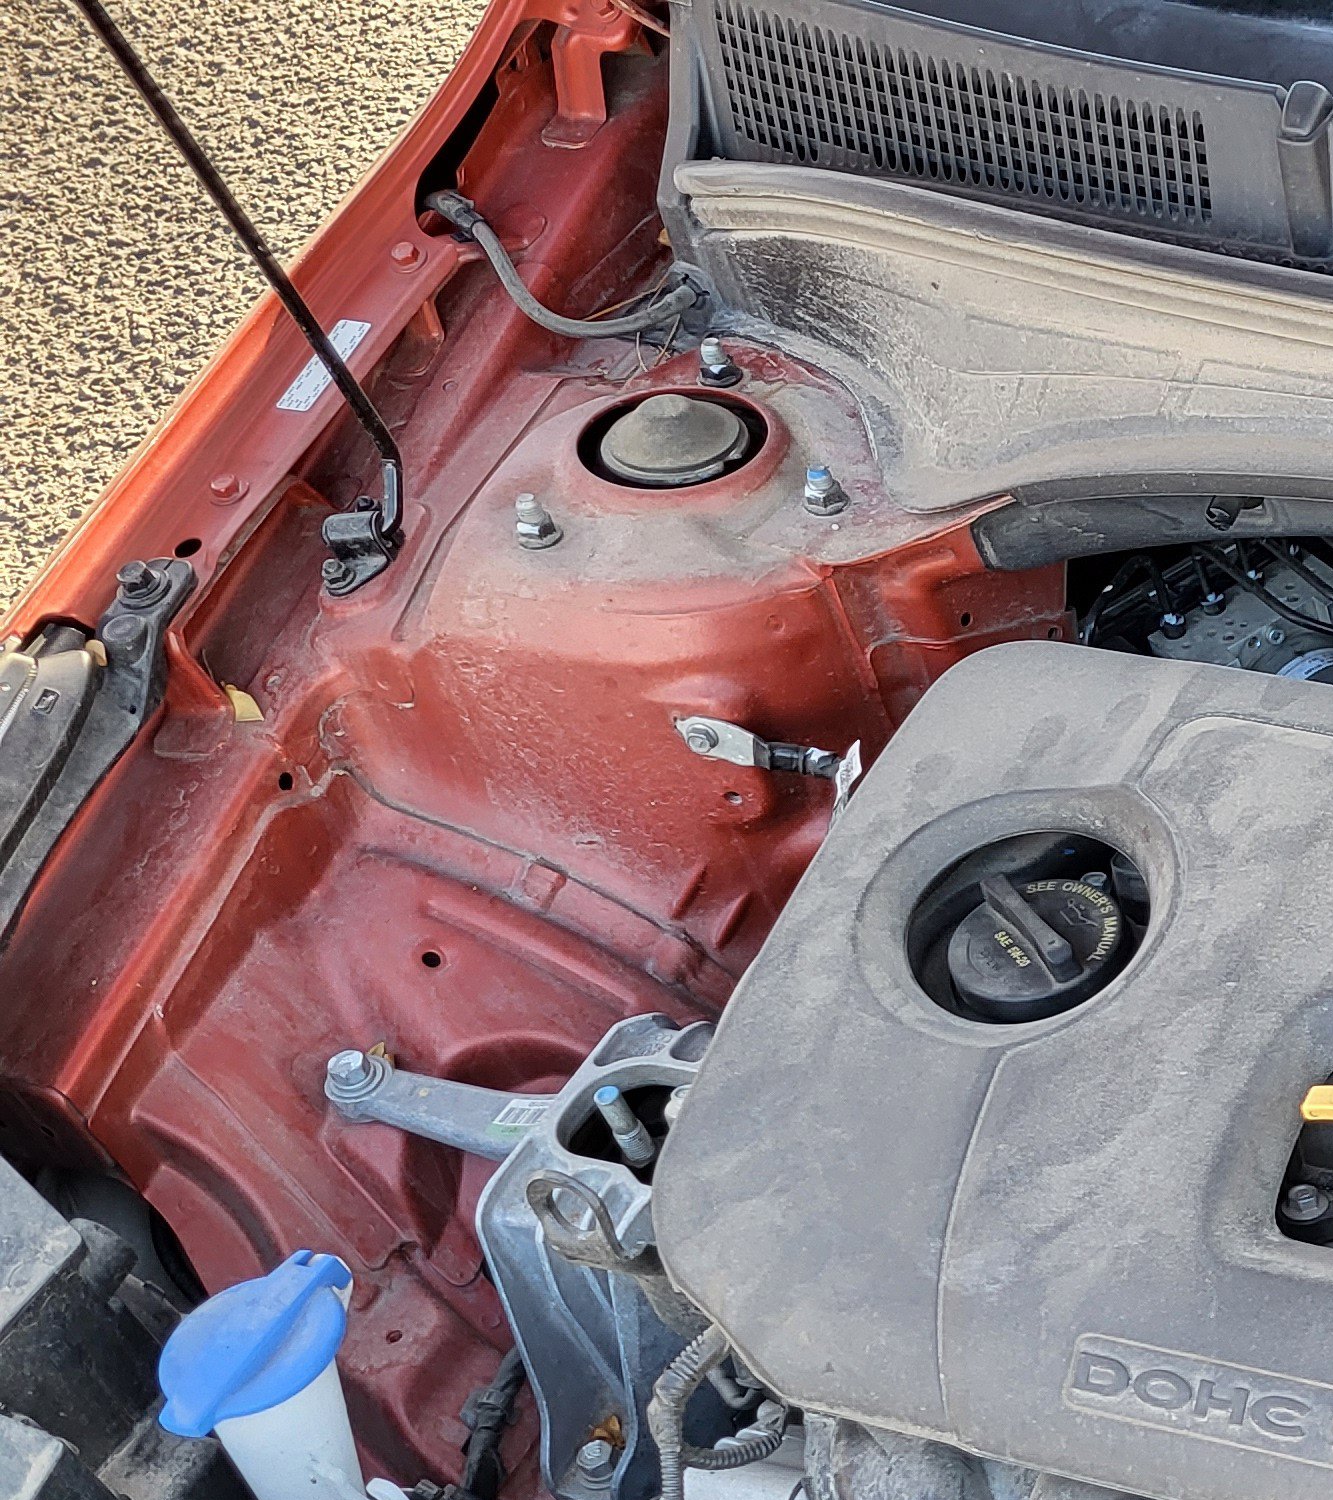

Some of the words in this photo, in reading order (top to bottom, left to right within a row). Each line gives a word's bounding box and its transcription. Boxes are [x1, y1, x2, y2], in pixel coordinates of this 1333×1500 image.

[1026, 881, 1056, 893] SEE
[1062, 881, 1113, 913] OWNER'S
[994, 931, 1013, 946] SAE
[1007, 946, 1031, 967] 5W-20
[1086, 915, 1117, 961] MANUAL
[1071, 1349, 1313, 1442] DOHC
